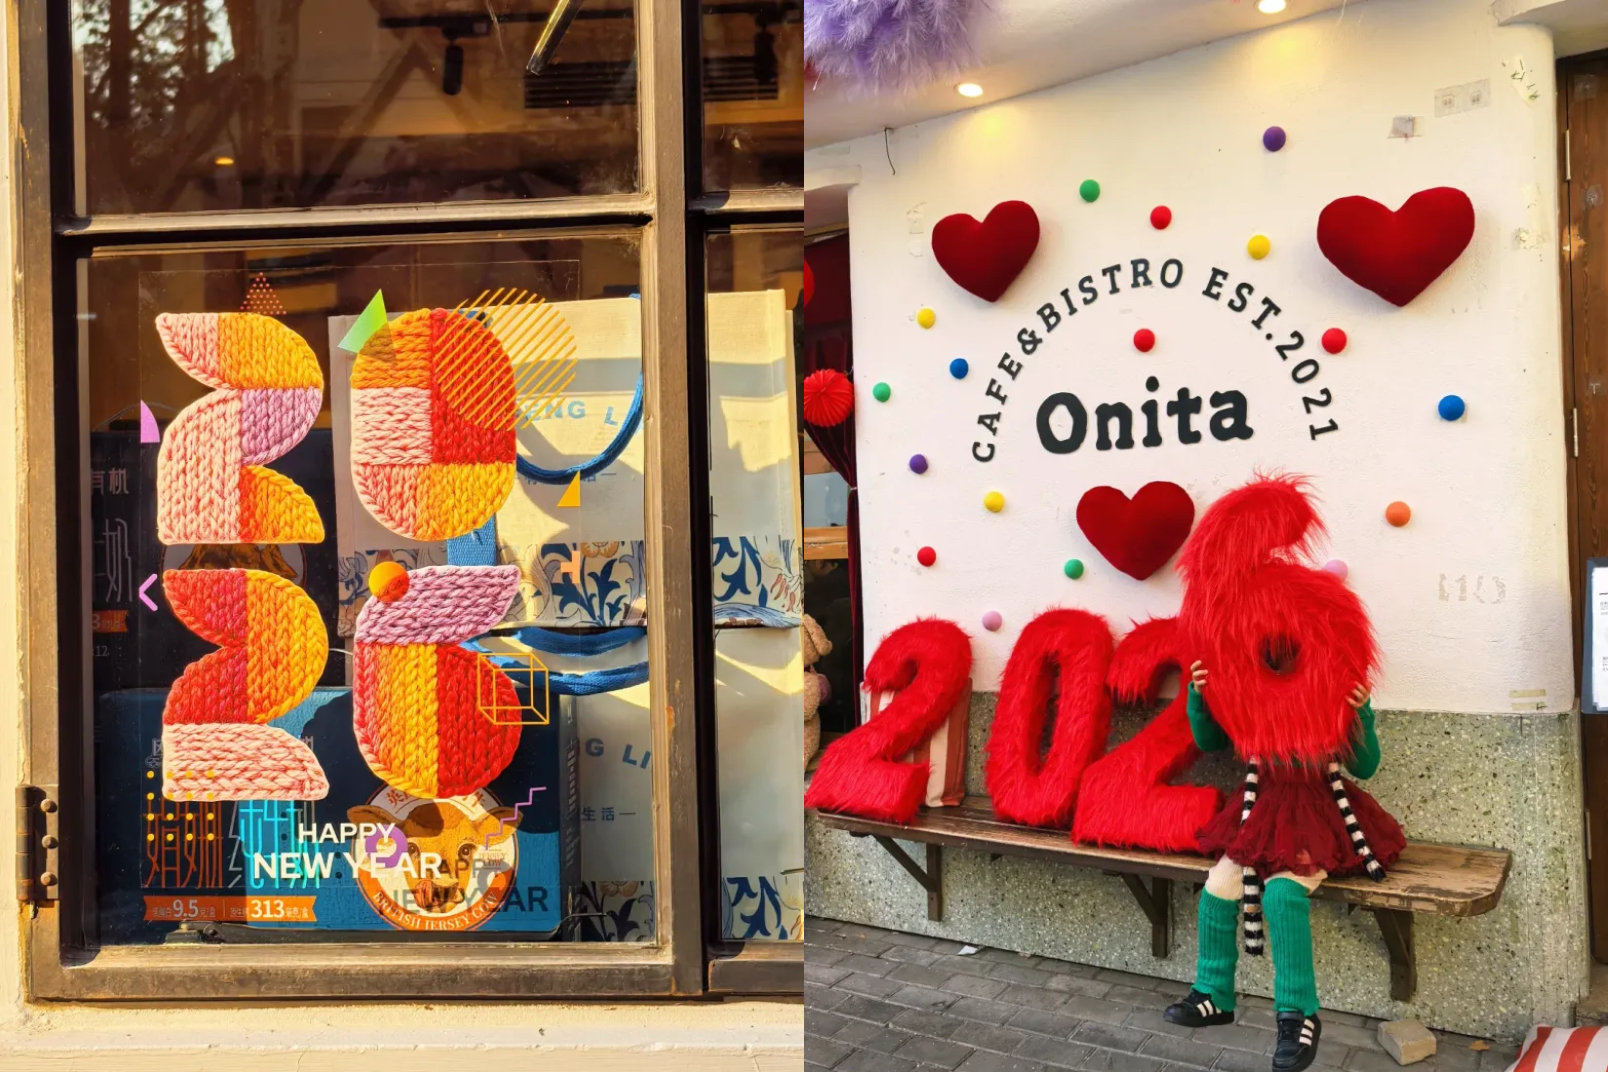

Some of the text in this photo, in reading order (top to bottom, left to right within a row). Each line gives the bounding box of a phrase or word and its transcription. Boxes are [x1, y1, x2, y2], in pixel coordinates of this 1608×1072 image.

[972, 257, 1340, 463] CAFE&BISTRO EST.2021
[1035, 375, 1255, 455] Onita
[298, 822, 396, 845] HAPPY
[253, 851, 443, 879] NEW YEAR
[372, 891, 421, 929] BRITISH
[471, 891, 499, 920] COW
